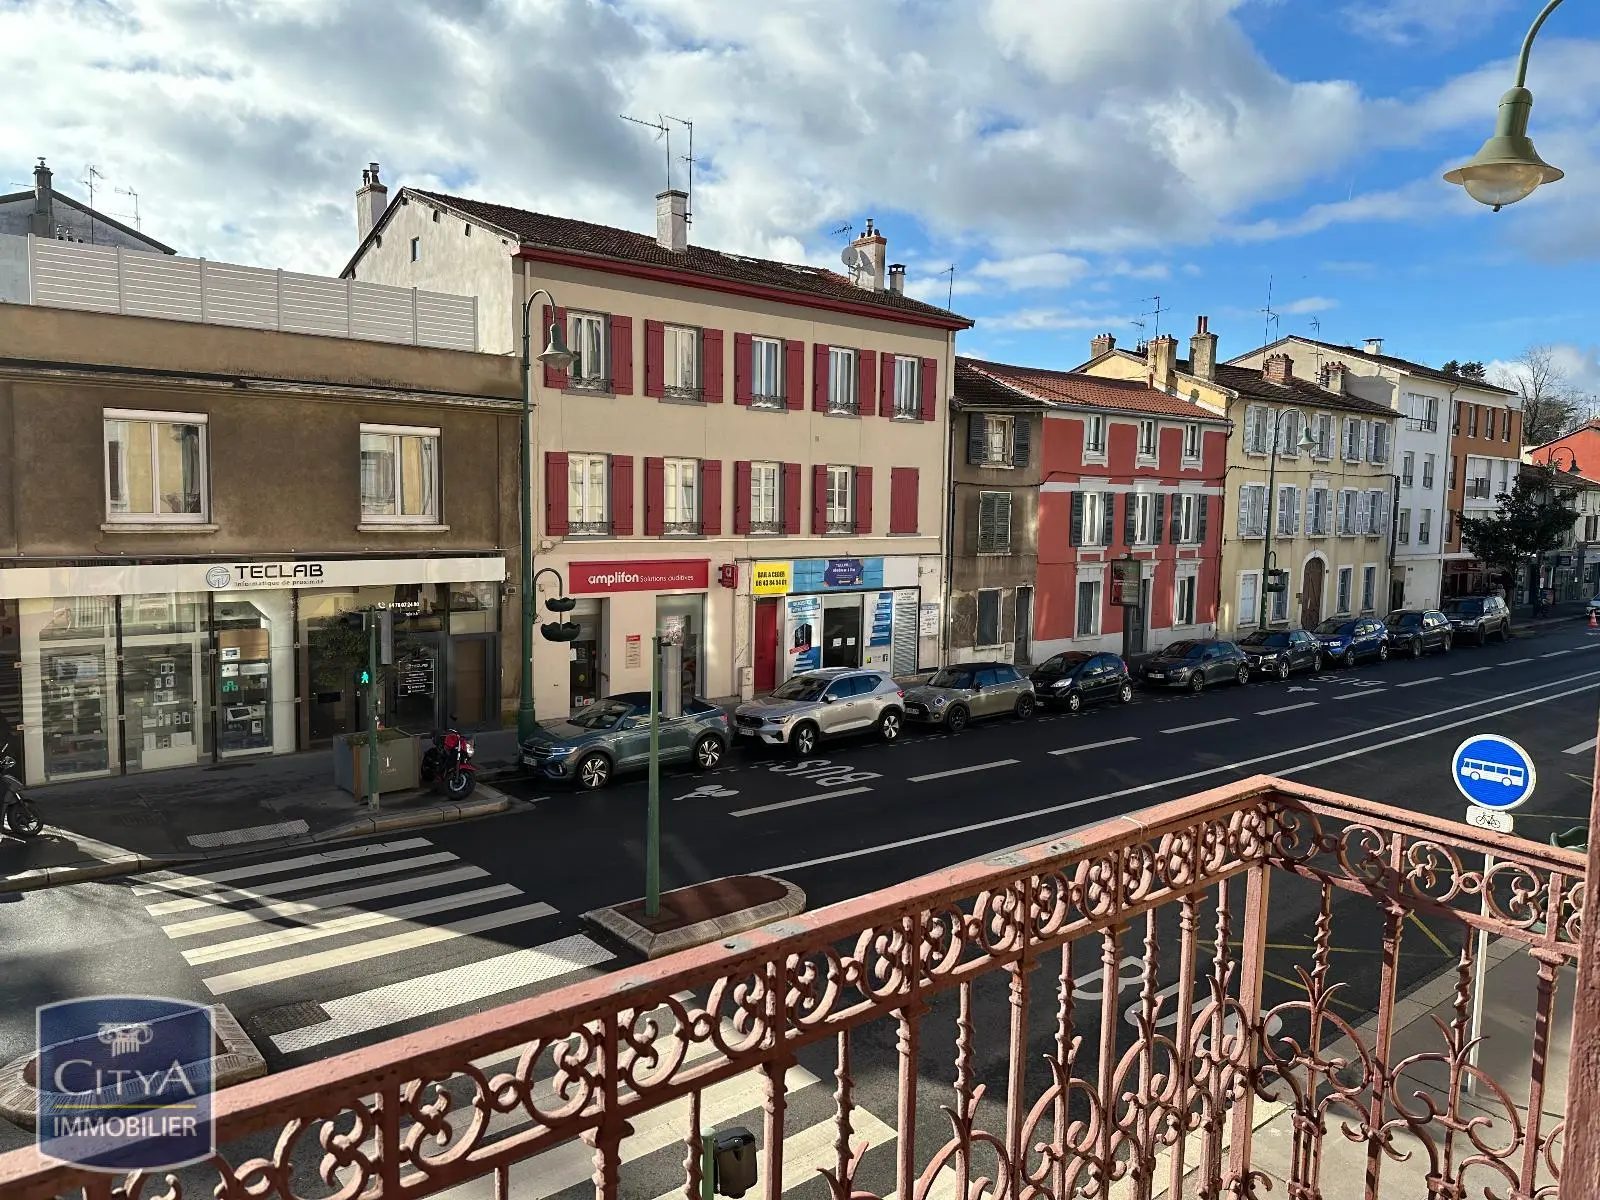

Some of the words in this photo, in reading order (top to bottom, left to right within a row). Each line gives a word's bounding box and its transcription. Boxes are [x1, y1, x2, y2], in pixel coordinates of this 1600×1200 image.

[234, 563, 324, 579] TECLAB
[588, 571, 639, 586] amplifon
[640, 575, 667, 583] Solutions
[668, 574, 694, 582] auditives
[769, 759, 885, 787] BUS
